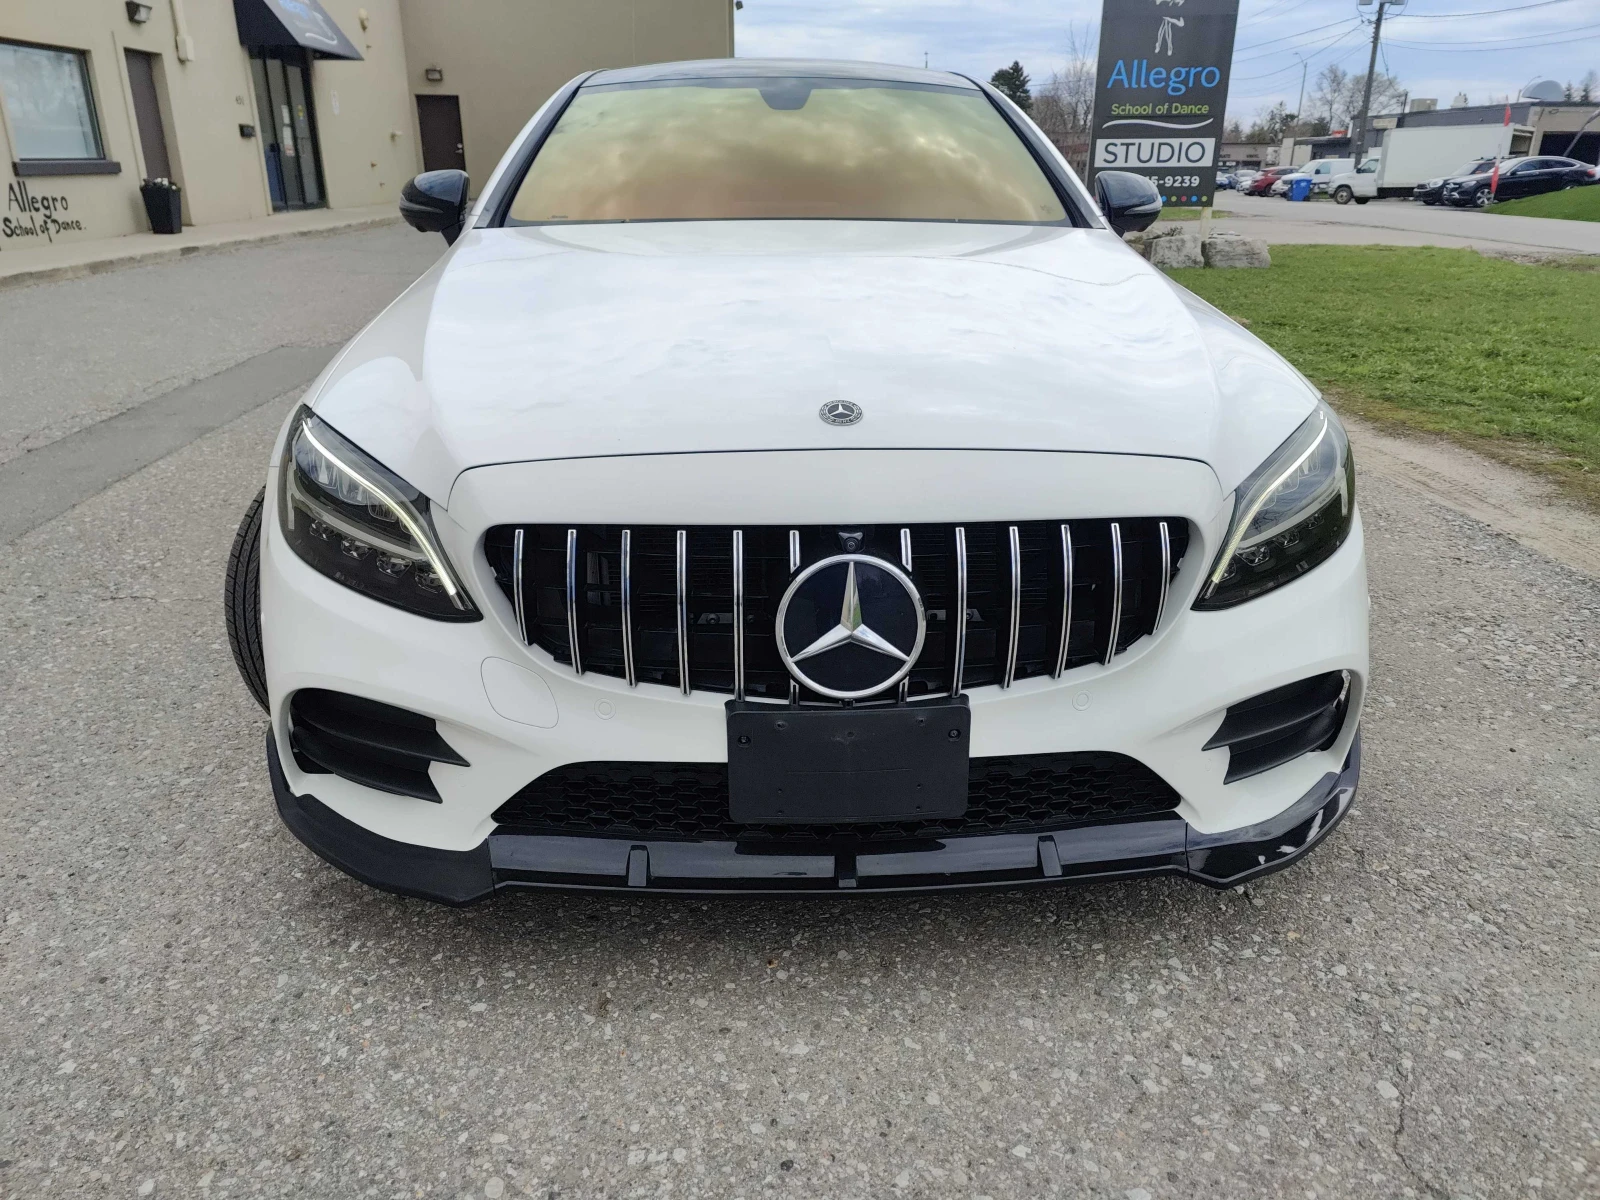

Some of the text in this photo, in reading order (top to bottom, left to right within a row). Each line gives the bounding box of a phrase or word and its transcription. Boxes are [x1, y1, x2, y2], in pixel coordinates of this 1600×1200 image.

[1107, 59, 1220, 95] Allegro
[1111, 102, 1209, 114] School of Dance
[1103, 142, 1205, 164] STUDIO
[1144, 175, 1200, 187] 5-9239
[8, 180, 69, 220] Allegro
[2, 215, 39, 238] School
[39, 219, 52, 243] of
